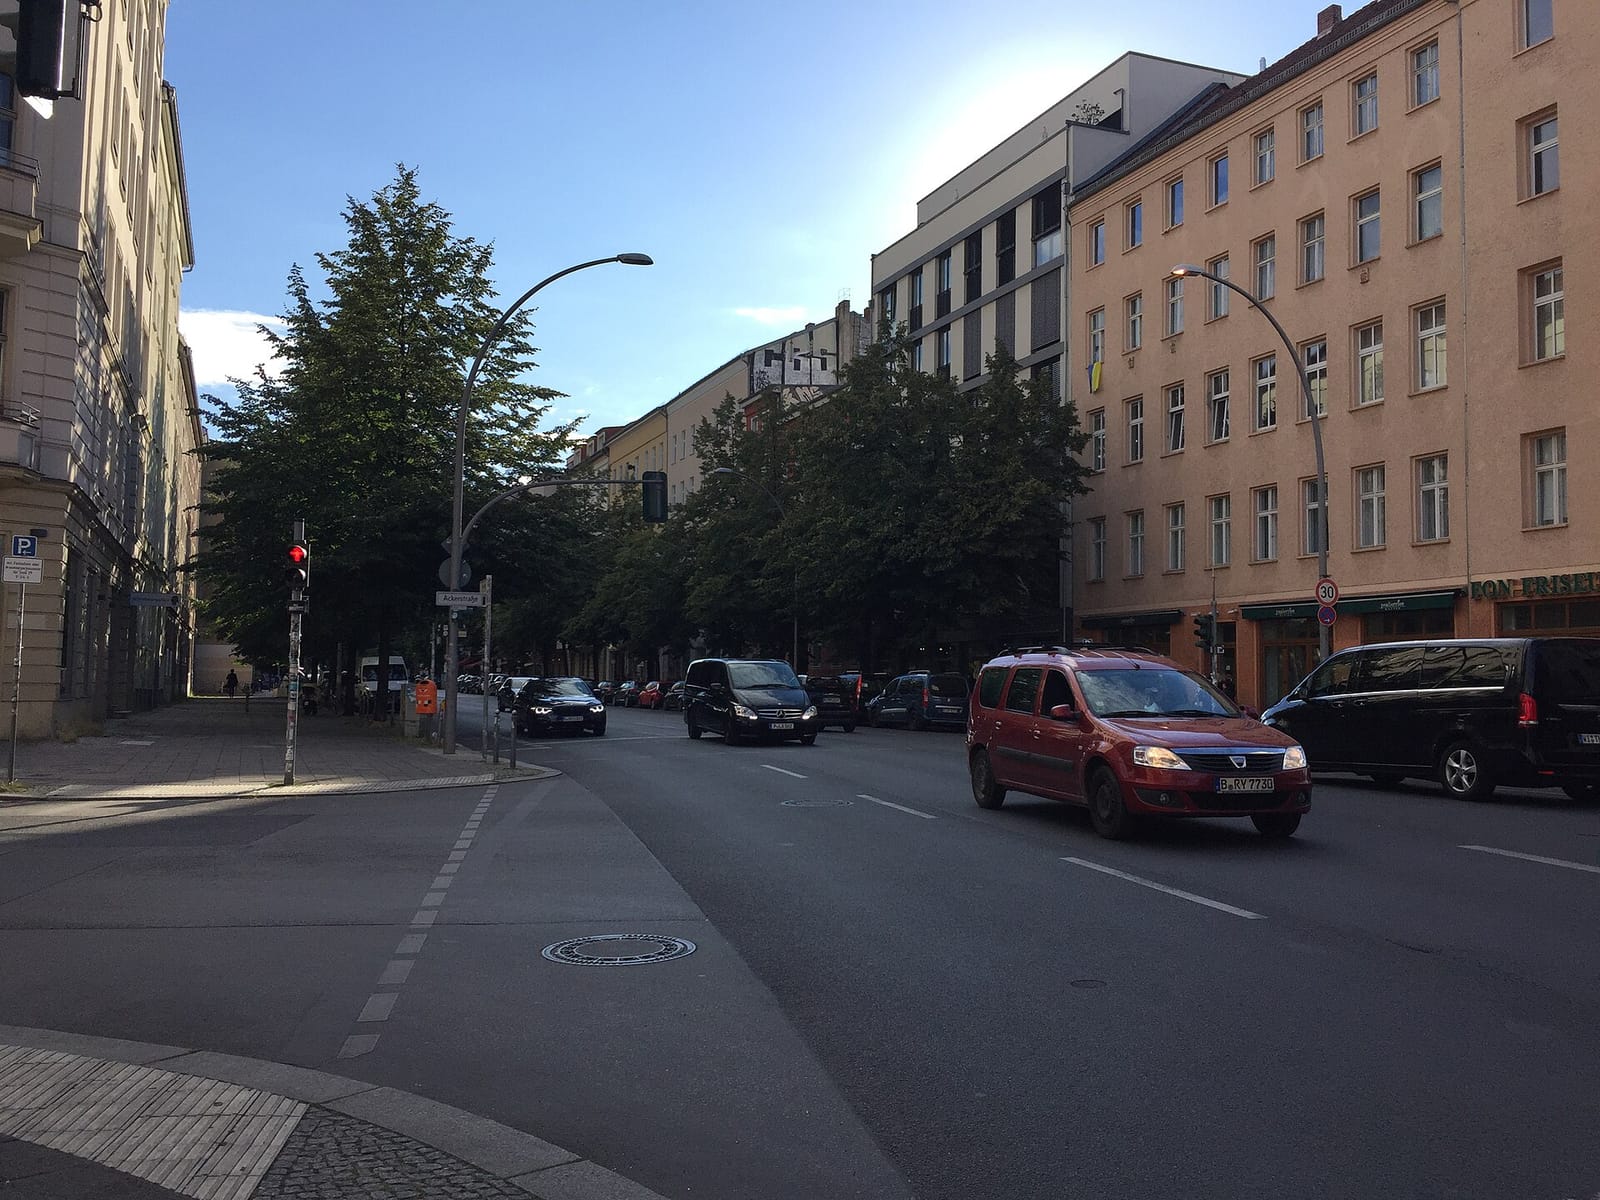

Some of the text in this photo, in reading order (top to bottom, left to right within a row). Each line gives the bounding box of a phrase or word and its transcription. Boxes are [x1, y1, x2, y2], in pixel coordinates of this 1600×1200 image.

[17, 538, 31, 554] P
[1320, 586, 1334, 599] 30
[443, 594, 478, 605] Ackerstraße
[1220, 778, 1274, 790] B RY 7730
